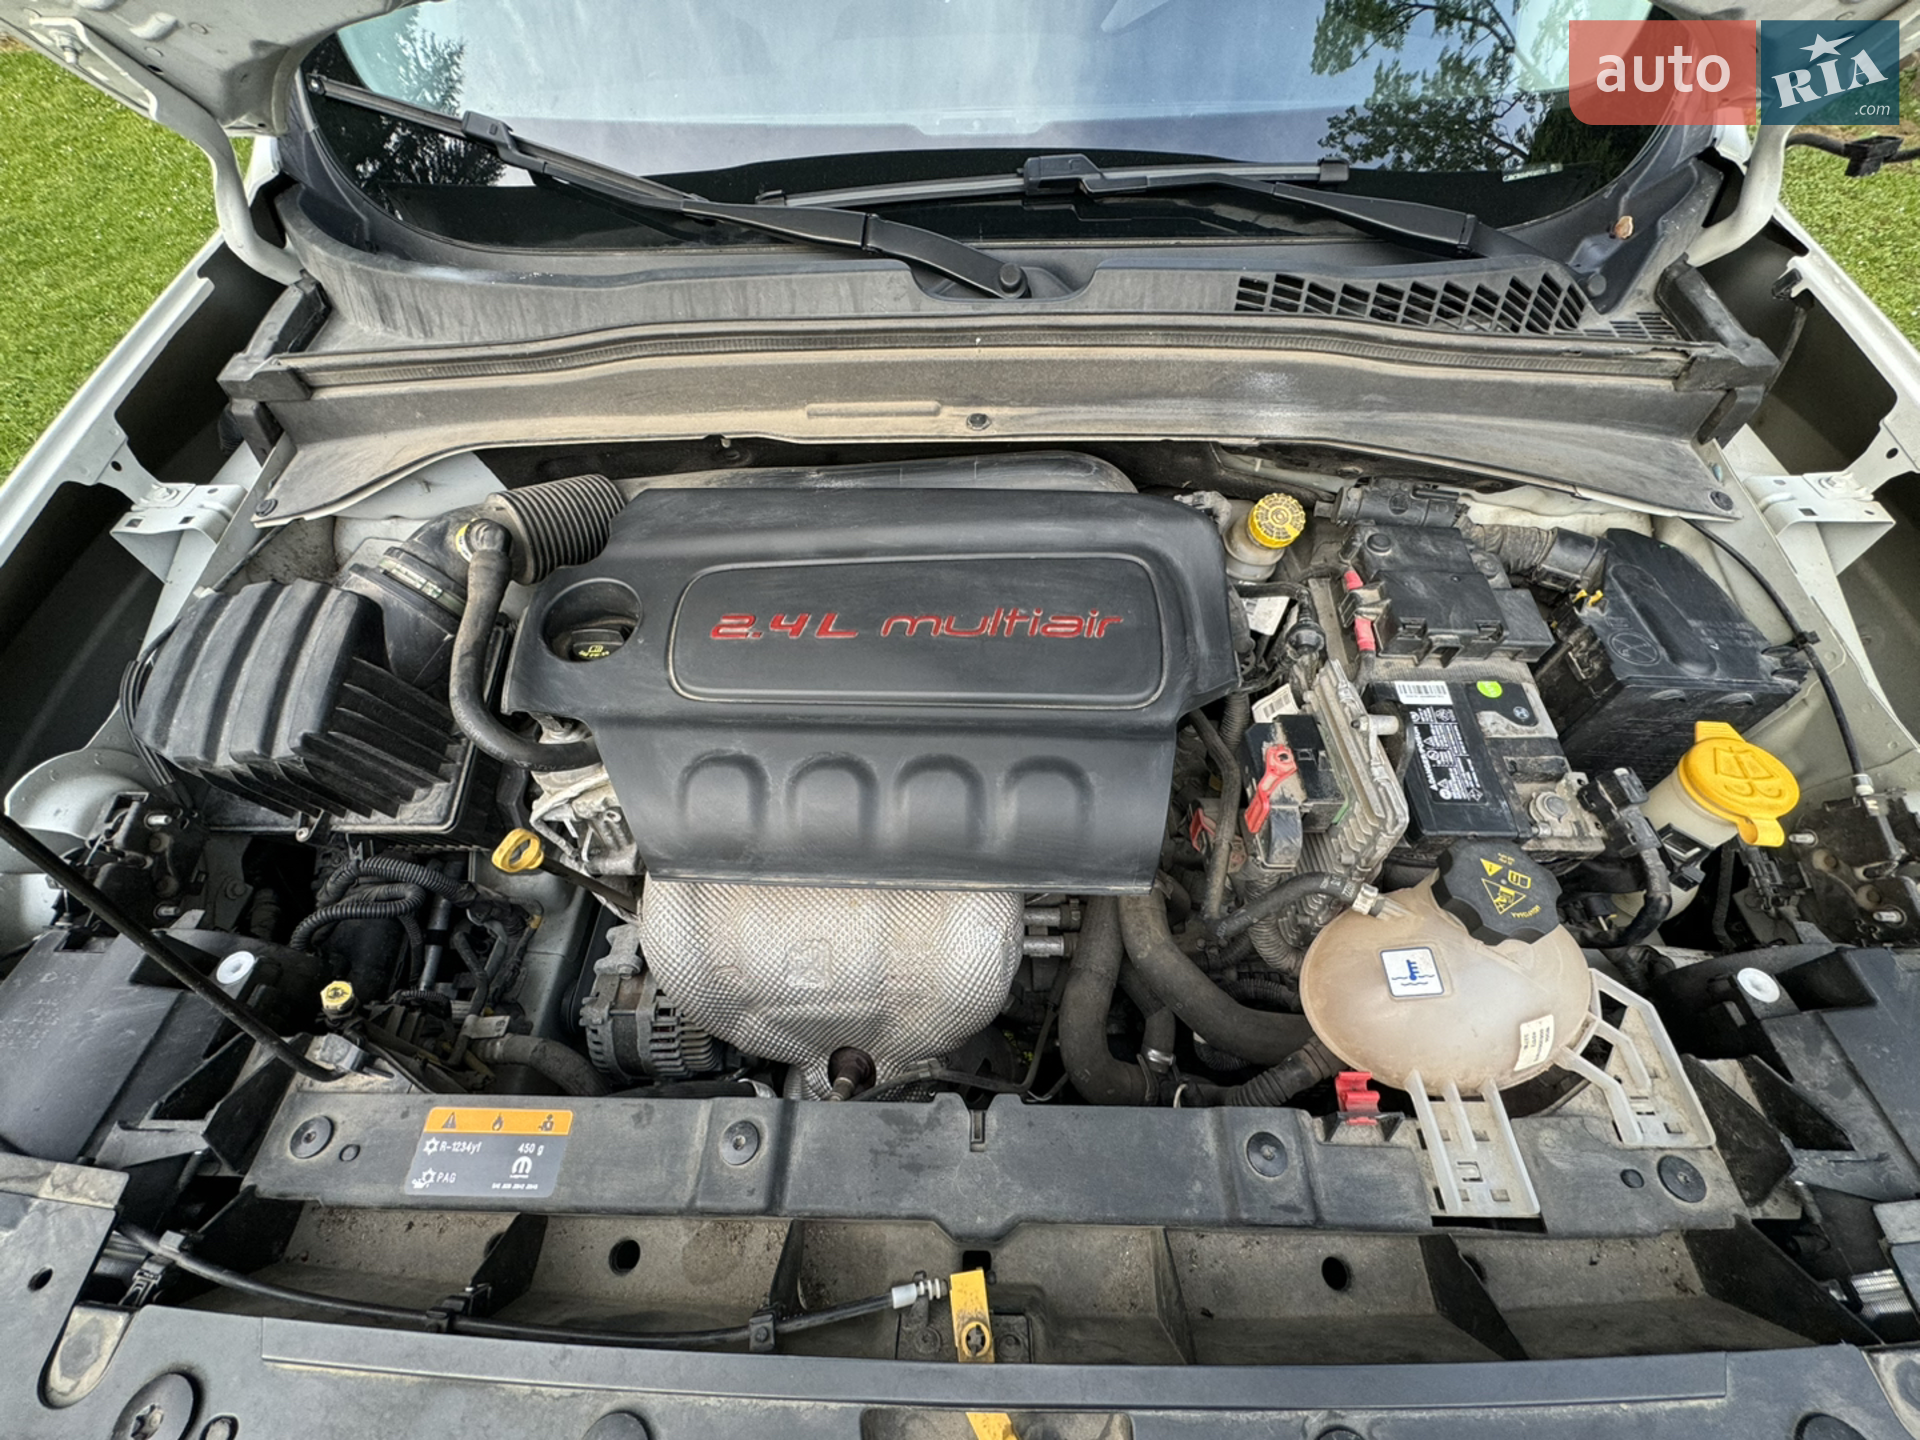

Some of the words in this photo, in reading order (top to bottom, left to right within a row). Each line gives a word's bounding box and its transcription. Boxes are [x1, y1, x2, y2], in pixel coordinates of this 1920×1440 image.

[710, 612, 859, 640] 2.4L
[880, 607, 1123, 639] multiair
[439, 1140, 482, 1155] R-1234yf
[517, 1143, 536, 1154] 450
[536, 1144, 545, 1157] g
[435, 1172, 457, 1184] PAG
